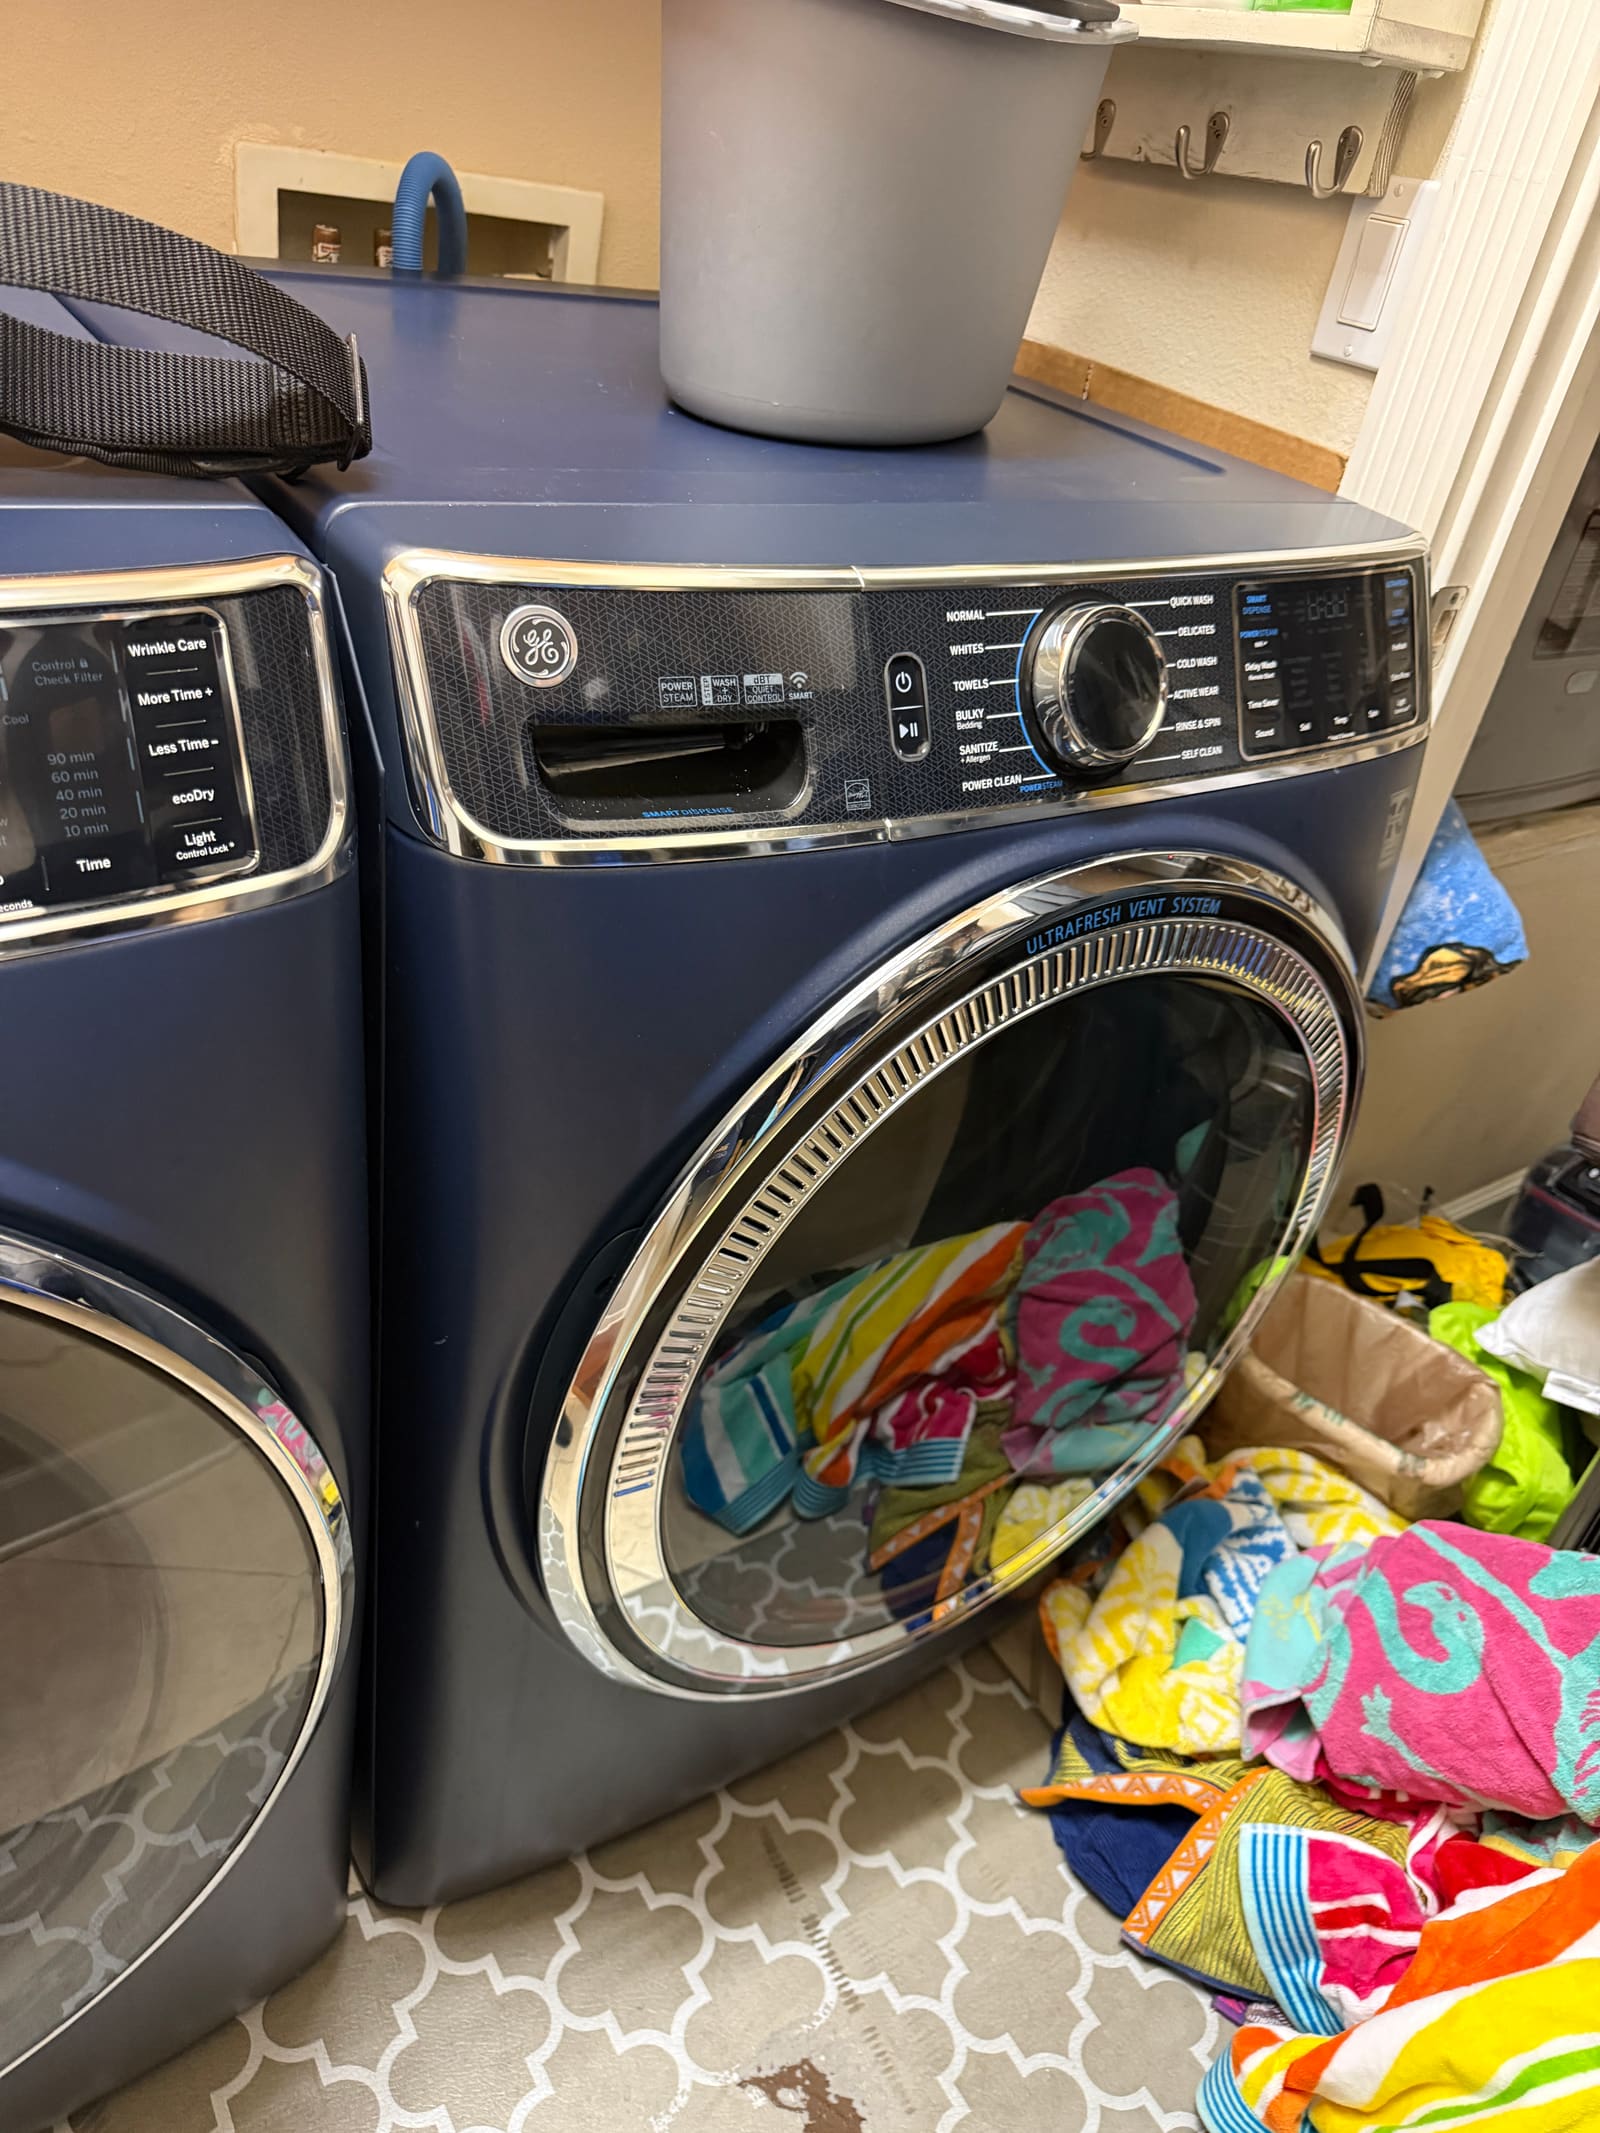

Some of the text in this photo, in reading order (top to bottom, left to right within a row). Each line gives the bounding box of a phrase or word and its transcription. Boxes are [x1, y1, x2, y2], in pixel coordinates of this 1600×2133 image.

[1170, 594, 1214, 608] QUICK WASH
[946, 610, 985, 622] NORMAL
[1178, 624, 1216, 637] DELICATES
[128, 638, 207, 658] Wrinkle Care
[950, 643, 984, 656] WHITES
[32, 659, 75, 672] Control
[1177, 656, 1218, 669] COLD WASH
[34, 671, 104, 686] Check Filter
[712, 677, 736, 687] WASH
[953, 679, 989, 692] TOWELS
[661, 681, 693, 692] POWER
[1173, 685, 1219, 700] ACTIVE WEAR
[138, 691, 170, 706] More
[172, 687, 202, 702] Time
[663, 692, 693, 703] STEAM
[718, 694, 732, 703] DRY
[789, 691, 814, 700] SMART
[2, 713, 30, 725] Cool
[956, 708, 984, 721] BULKY
[956, 721, 983, 731] Bedding
[1176, 720, 1198, 732] RINSE
[1204, 717, 1221, 728] SPIN
[149, 743, 177, 757] Less
[178, 738, 209, 752] Time
[959, 741, 999, 755] SANITIZE
[1182, 745, 1223, 760] SELF CLEAN
[47, 751, 95, 766] 90 min
[966, 755, 991, 764] Allergen
[51, 769, 99, 783] 60 min
[962, 774, 1022, 792] POWER CLEAN
[56, 787, 103, 801] 40 min
[172, 788, 215, 805] ecoDry
[60, 805, 106, 820] 20 min
[64, 823, 109, 837] 10 min
[184, 830, 216, 847] Light
[176, 843, 229, 861] Control Lock
[76, 858, 111, 872] Time
[1026, 896, 1221, 955] ULTRAFRESH VENT SYSTEM
